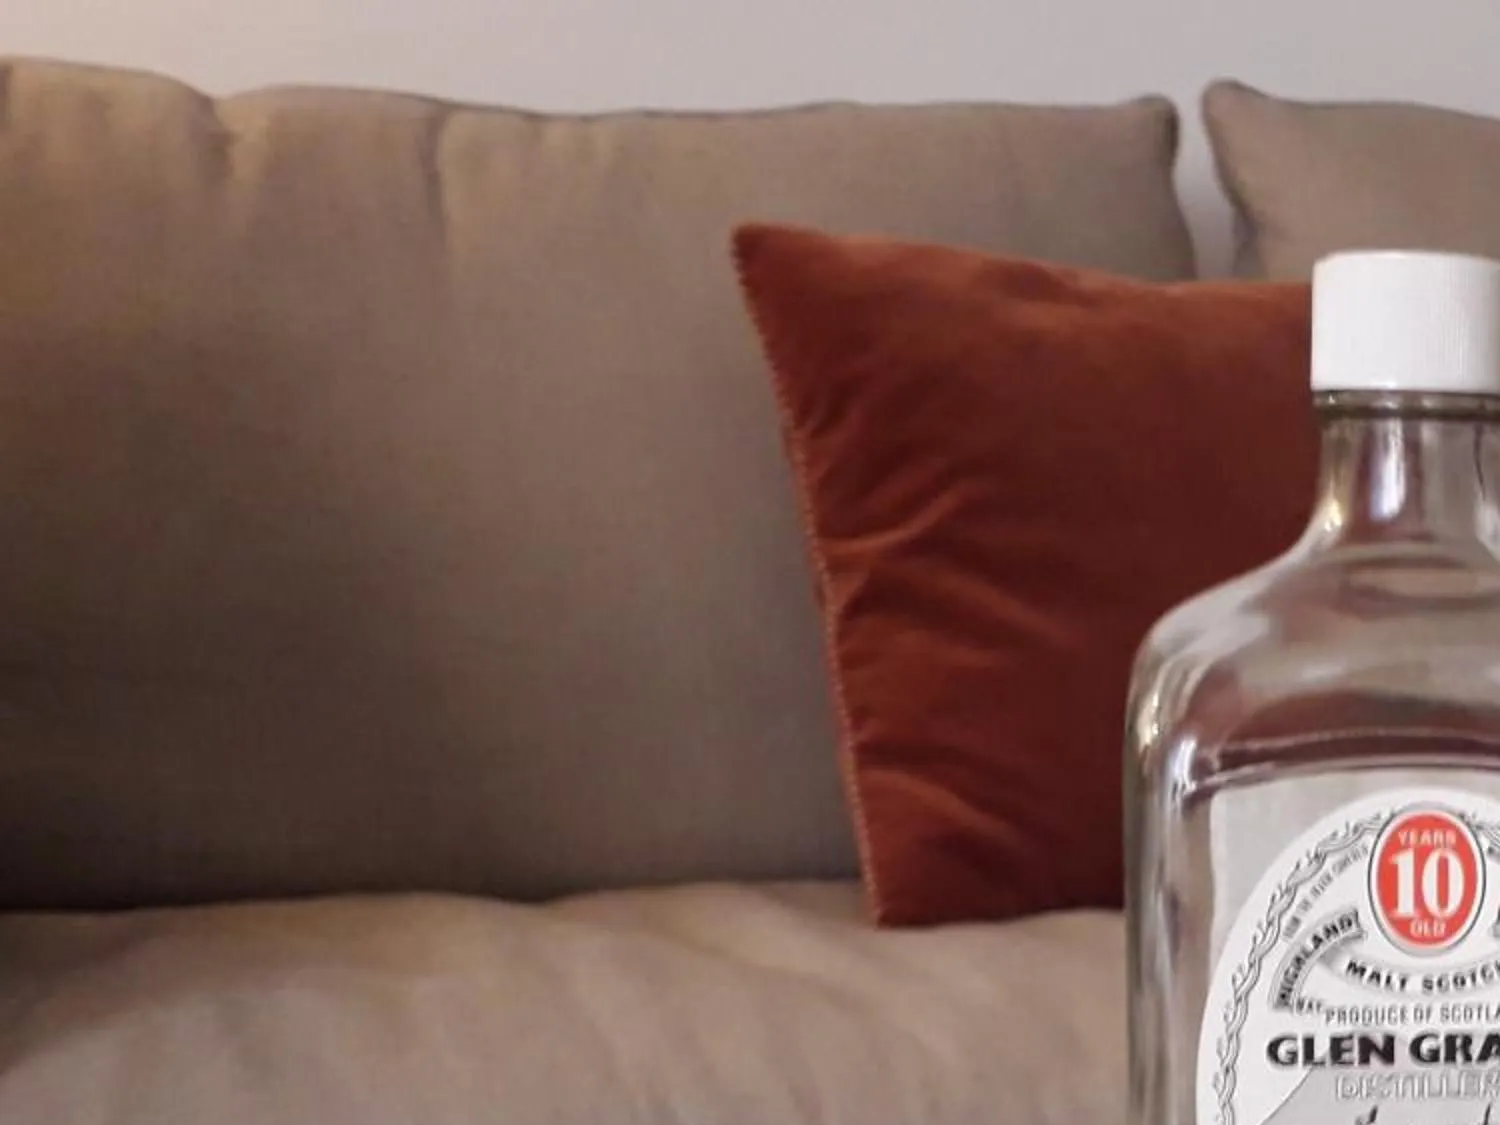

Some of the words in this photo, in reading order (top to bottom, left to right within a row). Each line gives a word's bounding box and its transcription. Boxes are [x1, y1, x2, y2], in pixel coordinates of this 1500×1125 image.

[1398, 828, 1457, 846] YEARS
[1388, 847, 1465, 919] 10
[1410, 918, 1446, 937] OLD
[1275, 912, 1354, 1010] HIGHLAND
[1346, 958, 1409, 992] MALT
[1325, 1005, 1408, 1026] PRODUCE
[1412, 1004, 1432, 1024] OF
[1265, 1033, 1395, 1068] GLEN
